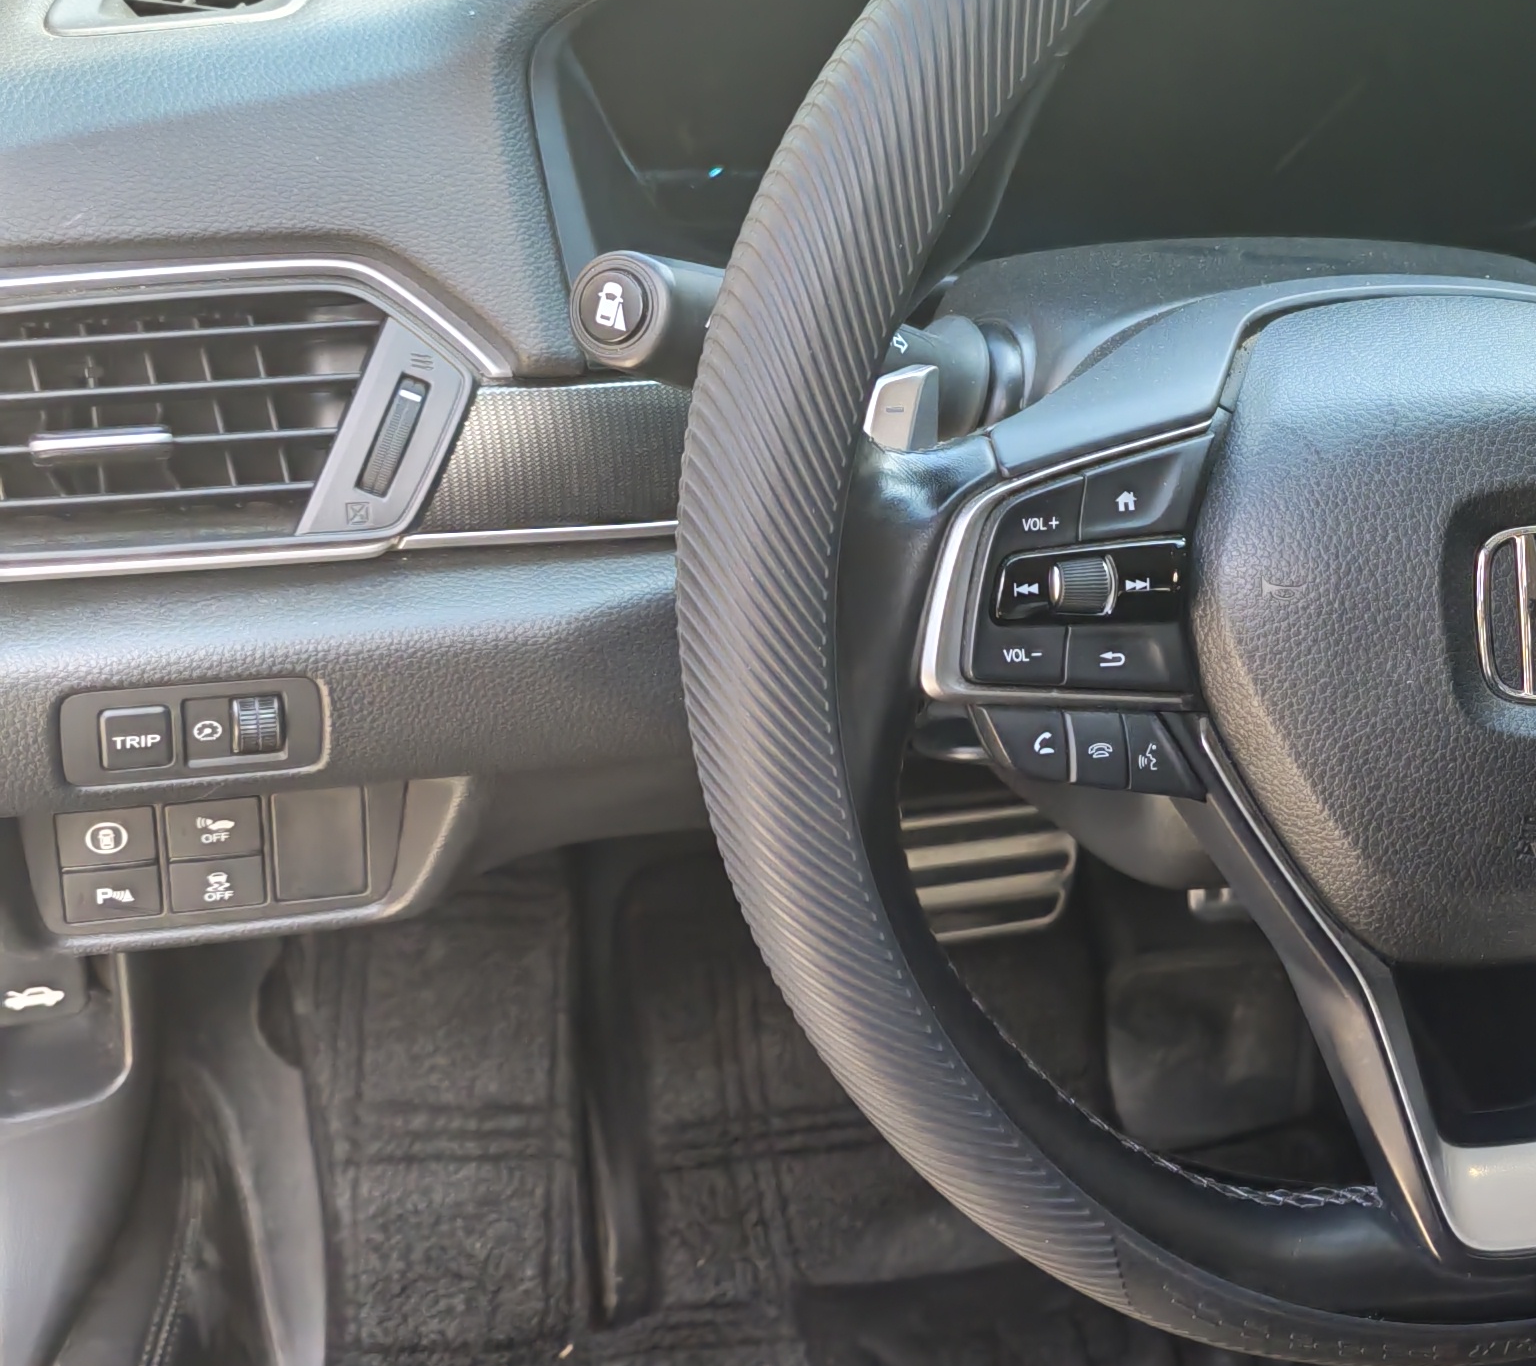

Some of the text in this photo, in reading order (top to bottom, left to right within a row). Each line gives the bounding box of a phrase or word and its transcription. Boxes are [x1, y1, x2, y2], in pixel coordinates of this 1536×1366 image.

[112, 733, 161, 751] TRIP
[201, 832, 230, 844] OFF
[204, 890, 234, 903] OFF
